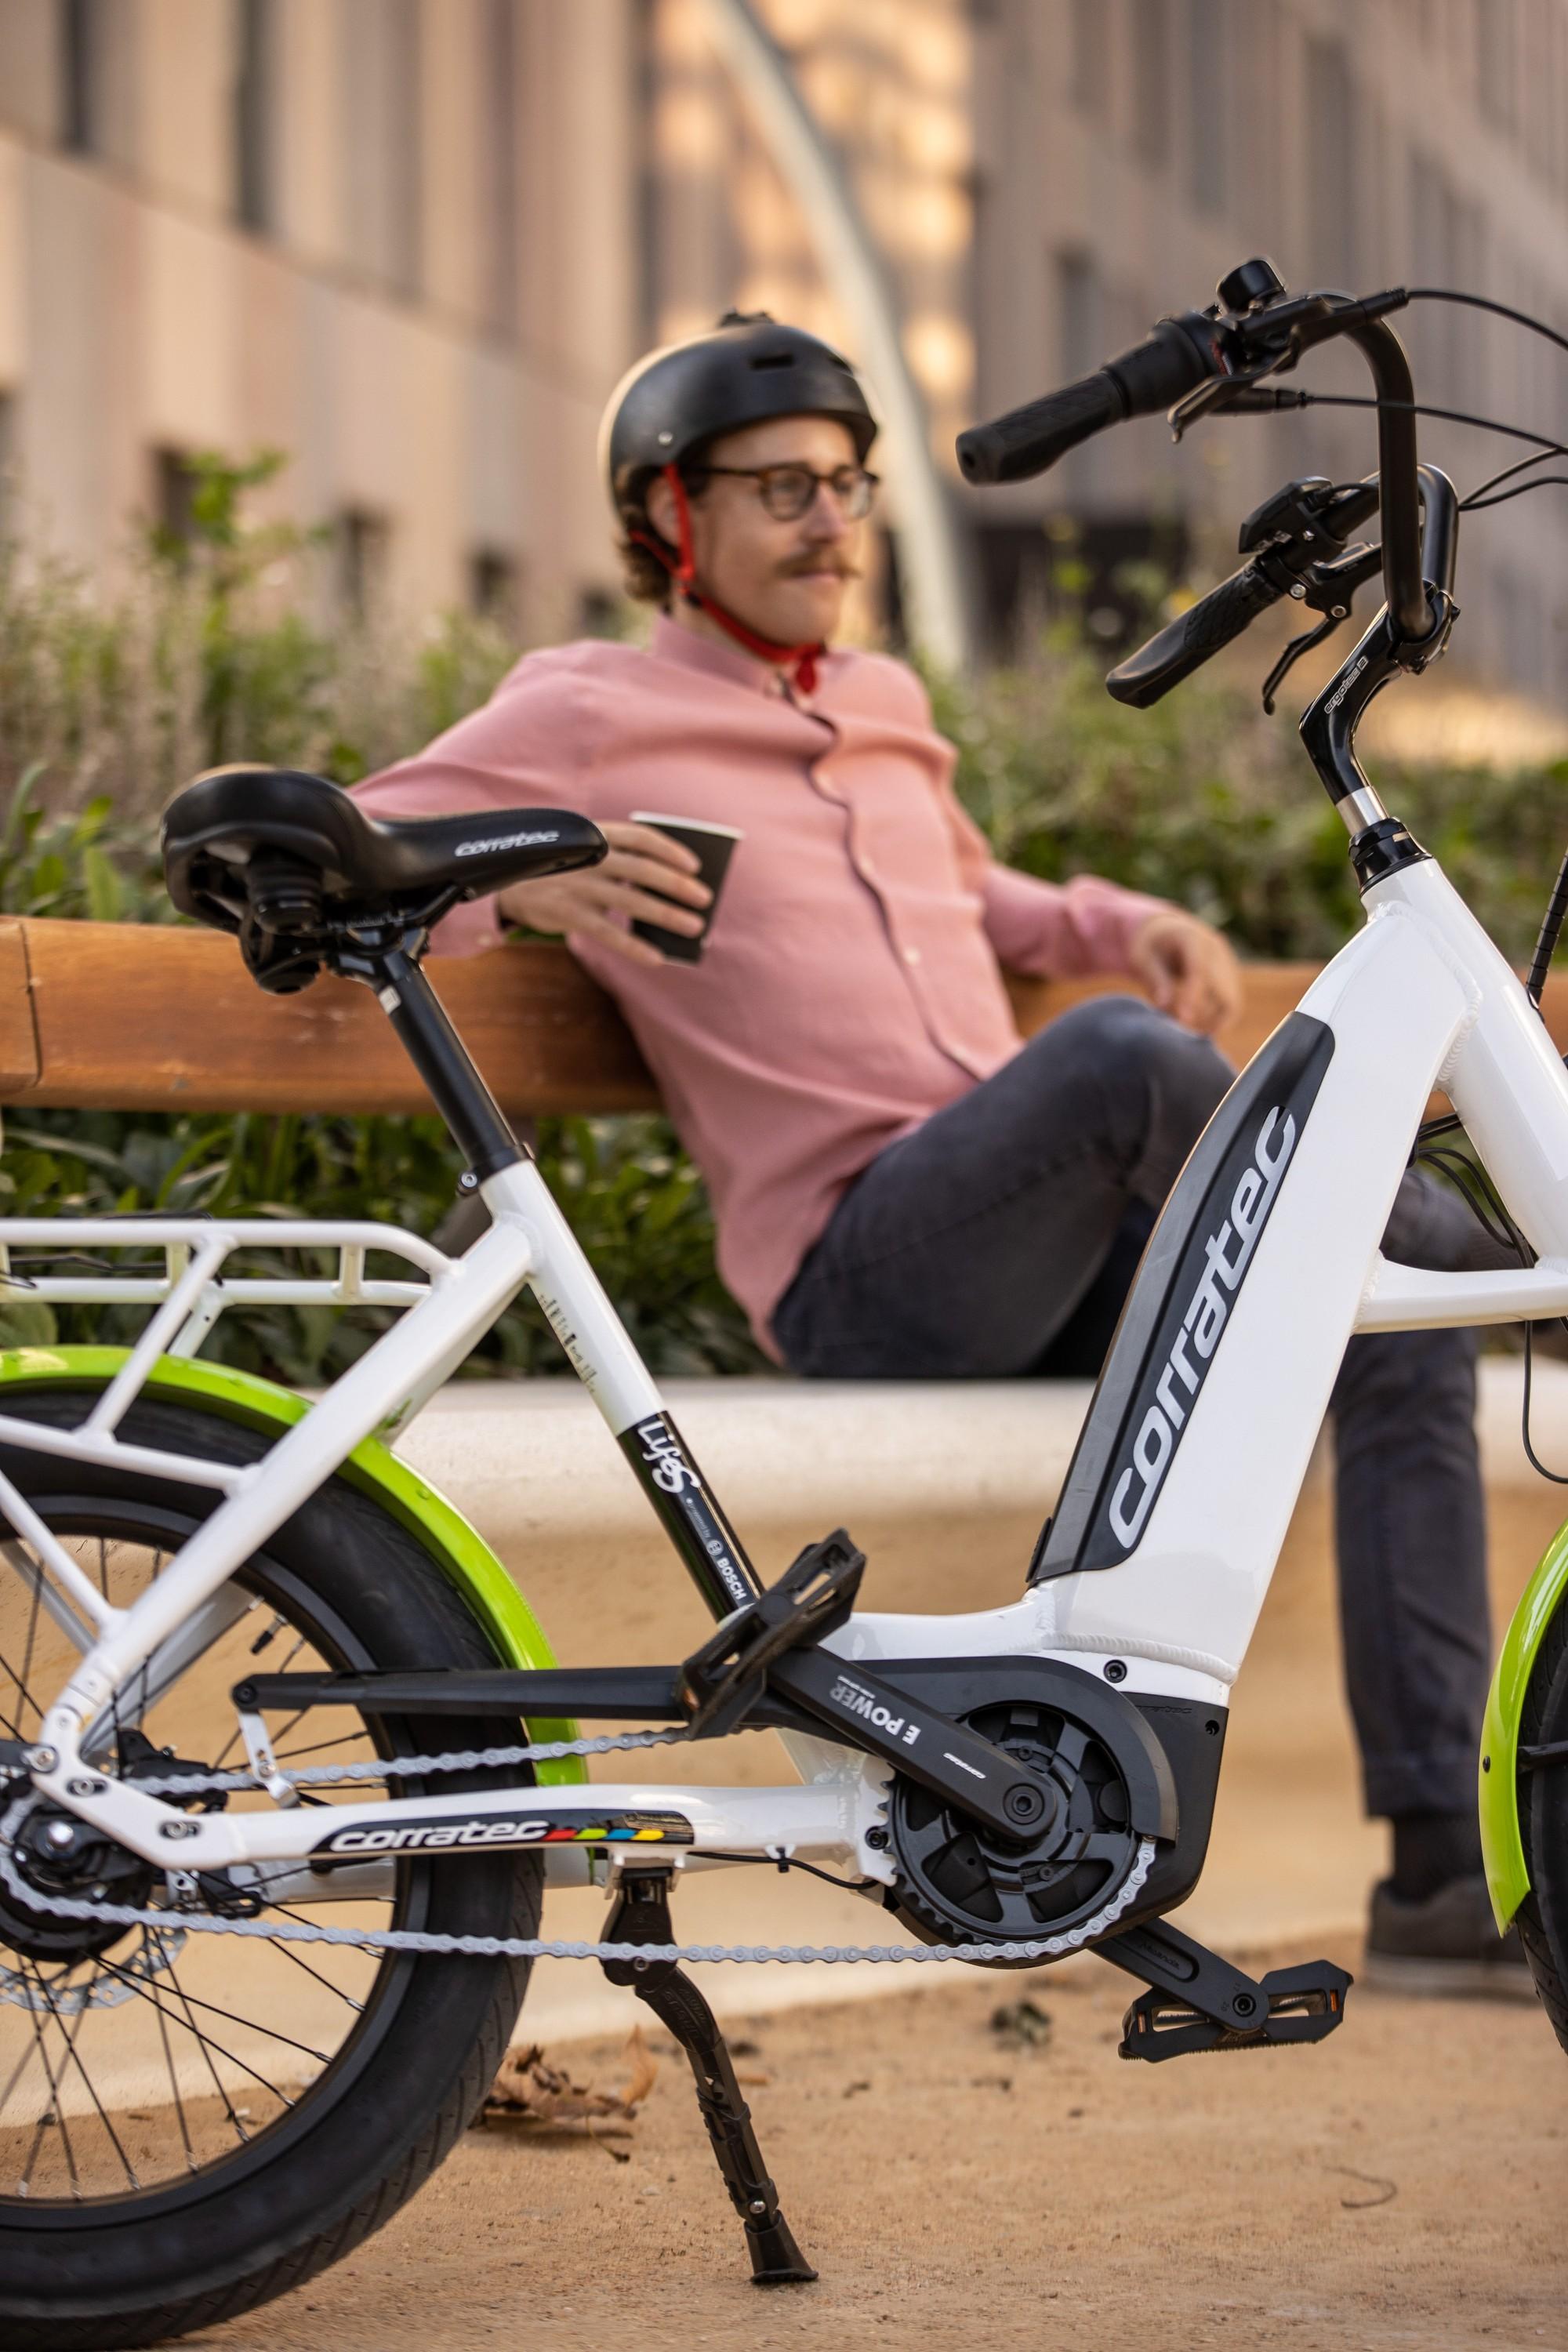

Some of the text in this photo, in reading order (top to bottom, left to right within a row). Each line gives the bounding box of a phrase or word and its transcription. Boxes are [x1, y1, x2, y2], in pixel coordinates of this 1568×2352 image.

[1324, 667, 1360, 714] ergotec
[454, 830, 560, 858] corratec
[1109, 1105, 1298, 1549] corratec
[717, 1556, 748, 1600] BOSCH
[829, 1683, 905, 1736] POWER
[902, 1725, 921, 1745] E
[942, 1752, 987, 1780] corratec
[330, 1820, 550, 1852] corratec
